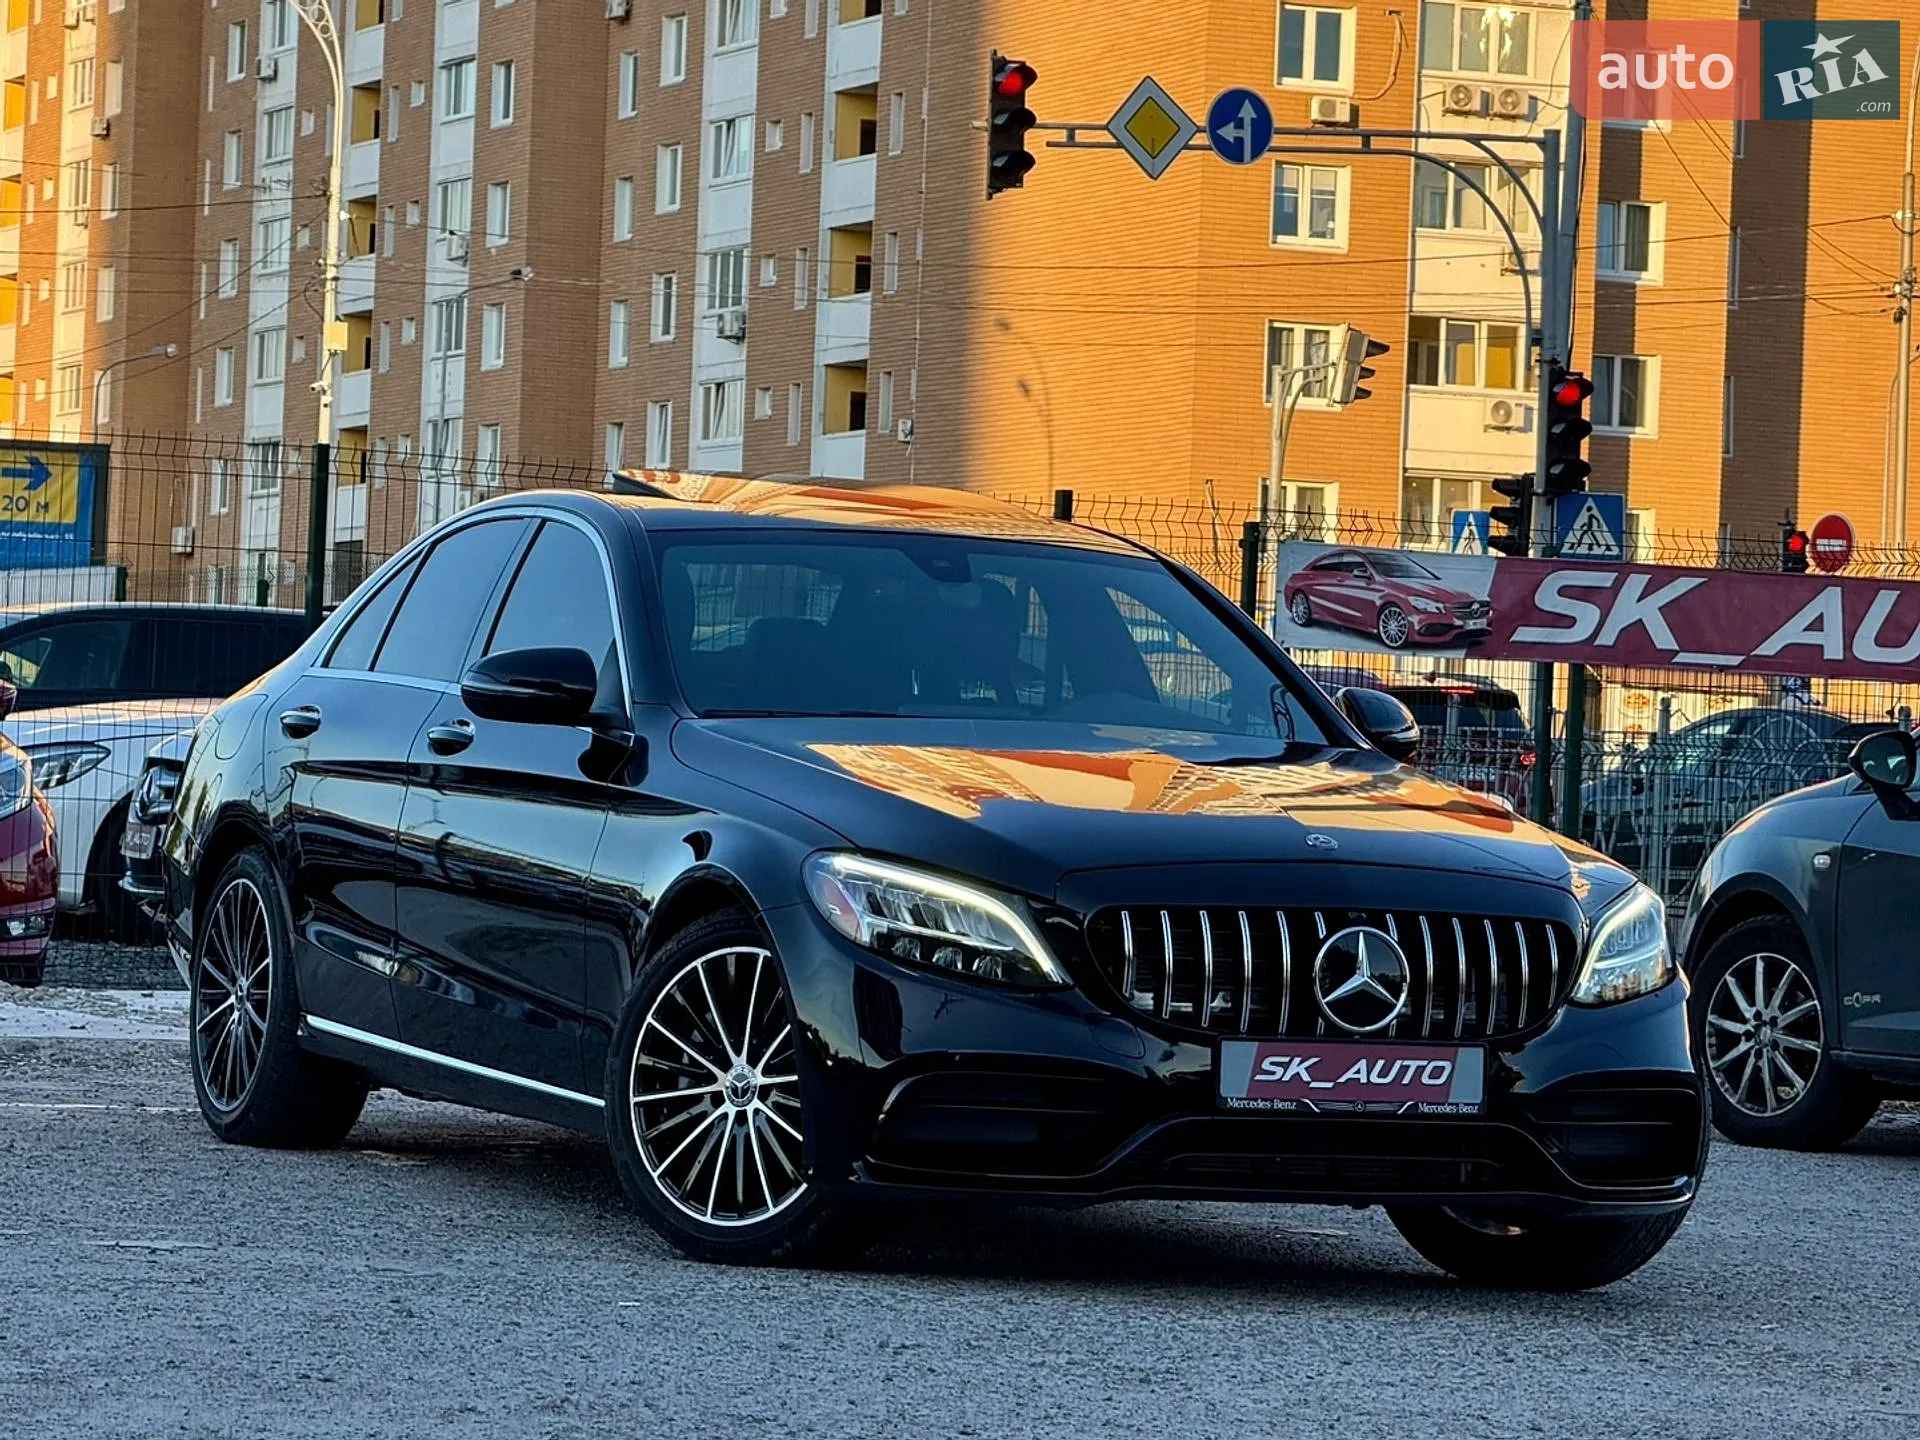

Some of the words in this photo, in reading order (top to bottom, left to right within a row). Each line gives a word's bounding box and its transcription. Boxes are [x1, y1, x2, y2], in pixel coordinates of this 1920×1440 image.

[2, 494, 28, 512] 20
[1254, 1056, 1453, 1088] SK_AUTO
[1227, 1097, 1297, 1110] Mercedes-Benz
[1418, 1102, 1479, 1114] Mercedes-Benz
